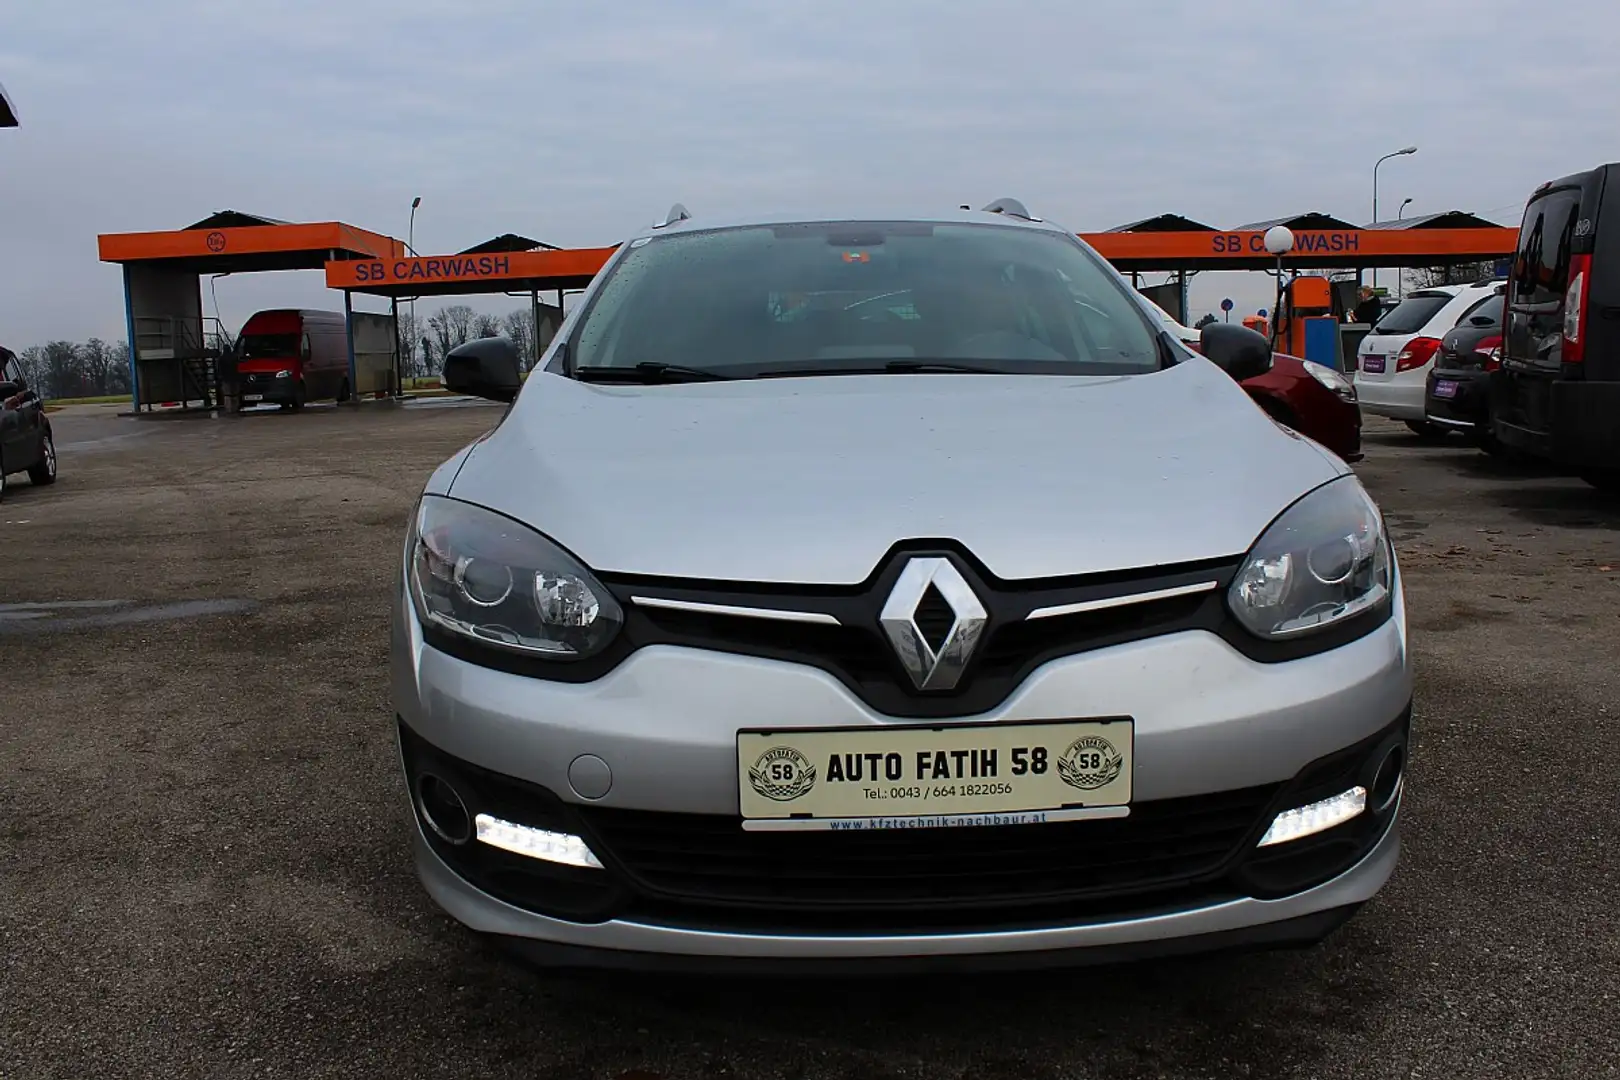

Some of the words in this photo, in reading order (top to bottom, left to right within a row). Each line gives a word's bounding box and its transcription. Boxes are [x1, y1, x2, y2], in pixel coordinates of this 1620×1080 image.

[1212, 234, 1242, 252] SB
[1249, 234, 1359, 252] CWASH
[355, 263, 385, 281] SB
[393, 256, 509, 279] CARWASH
[826, 752, 902, 782] AUTO
[916, 748, 998, 780] FATIH
[1011, 746, 1049, 776] 58
[1079, 753, 1101, 769] 58
[771, 764, 794, 780] 58
[863, 787, 887, 799] Tel.:
[890, 786, 921, 799] 0043
[933, 785, 956, 798] 664
[960, 783, 1013, 797] 1822056
[830, 812, 1047, 830] www.kfztechnik-nachbaur.at
